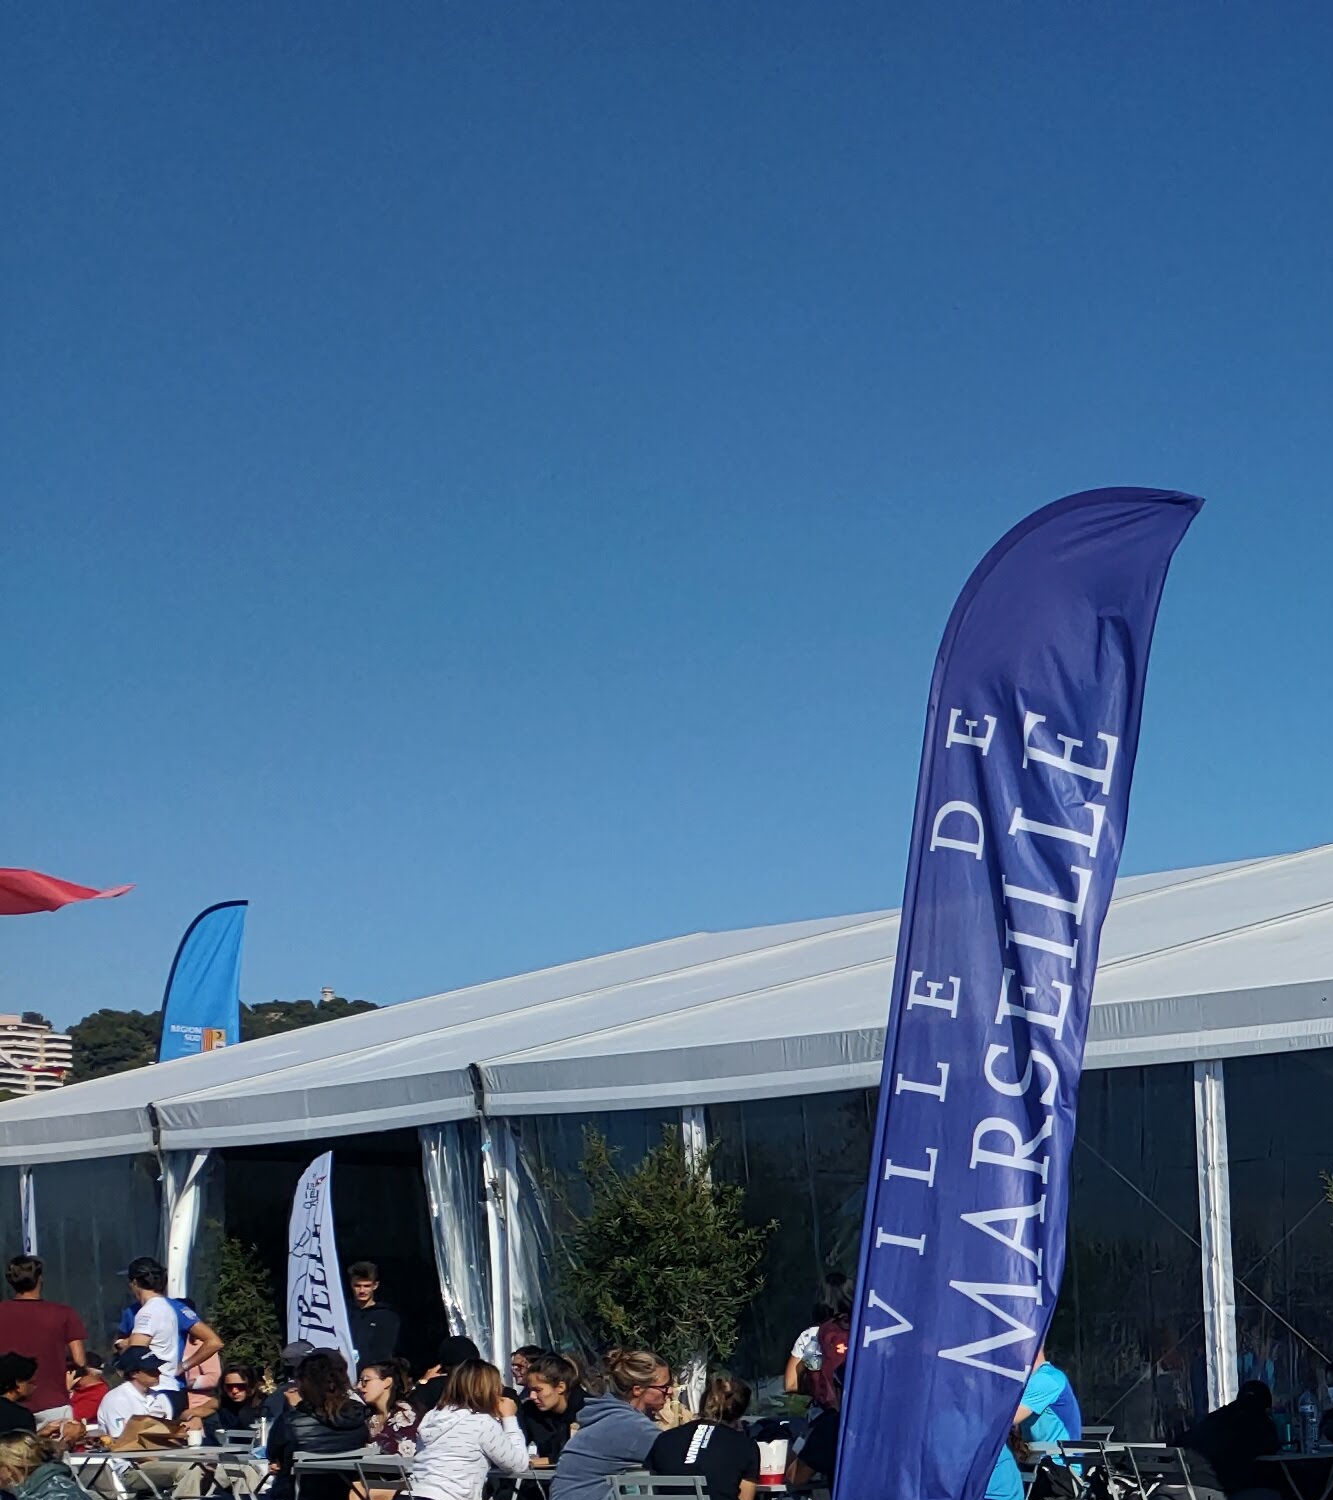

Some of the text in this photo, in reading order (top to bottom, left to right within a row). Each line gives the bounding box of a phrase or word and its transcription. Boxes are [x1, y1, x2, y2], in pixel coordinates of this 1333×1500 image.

[862, 708, 997, 1348] VILLE DE
[938, 710, 1119, 1382] MARSEILLE
